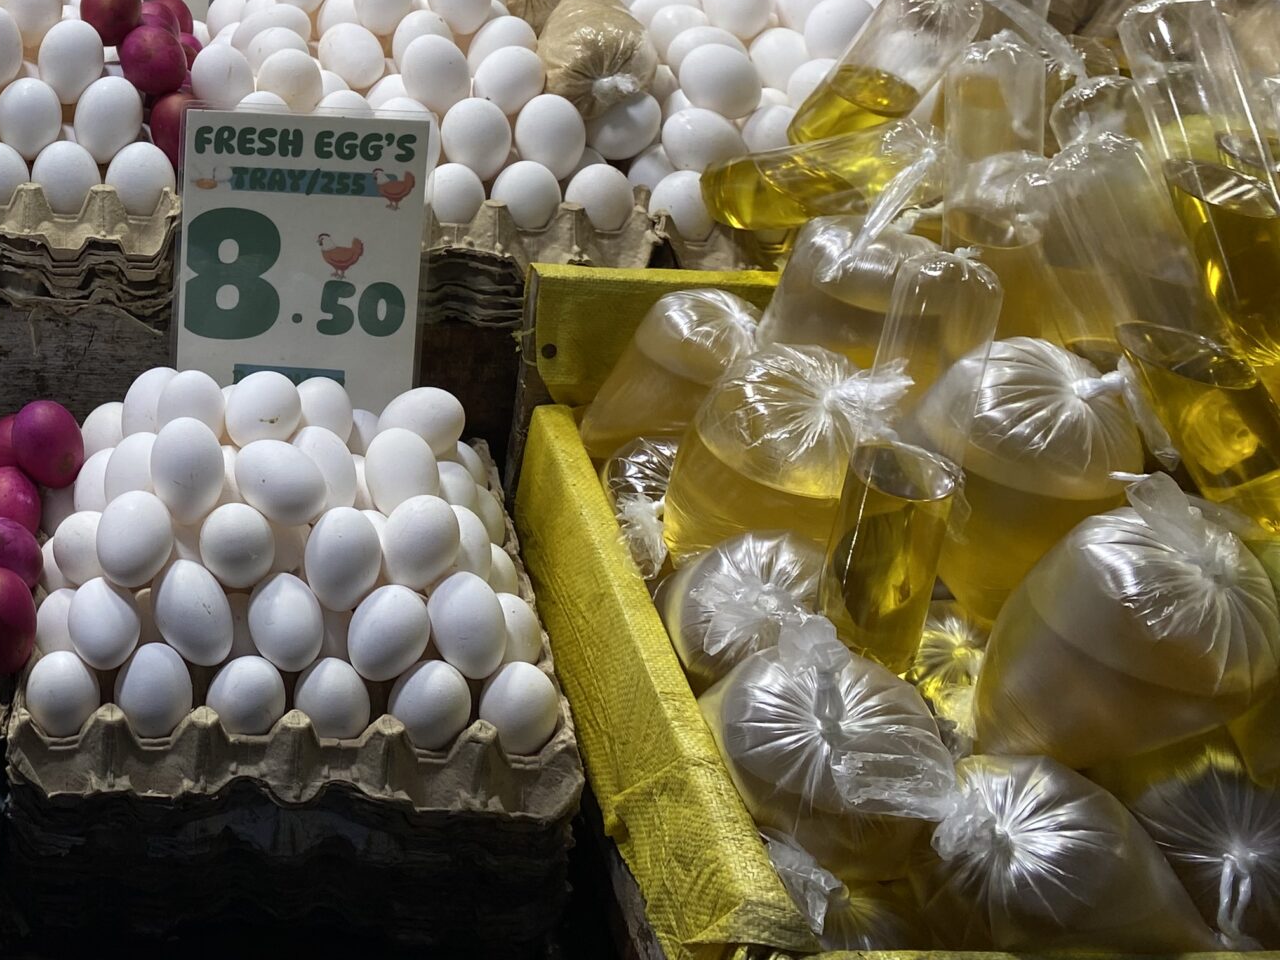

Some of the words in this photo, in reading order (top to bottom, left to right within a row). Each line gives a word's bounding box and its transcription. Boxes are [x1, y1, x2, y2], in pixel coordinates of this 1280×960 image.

[194, 125, 304, 158] FRESH
[314, 130, 417, 163] EGG'S
[231, 167, 367, 195] TRAY/255
